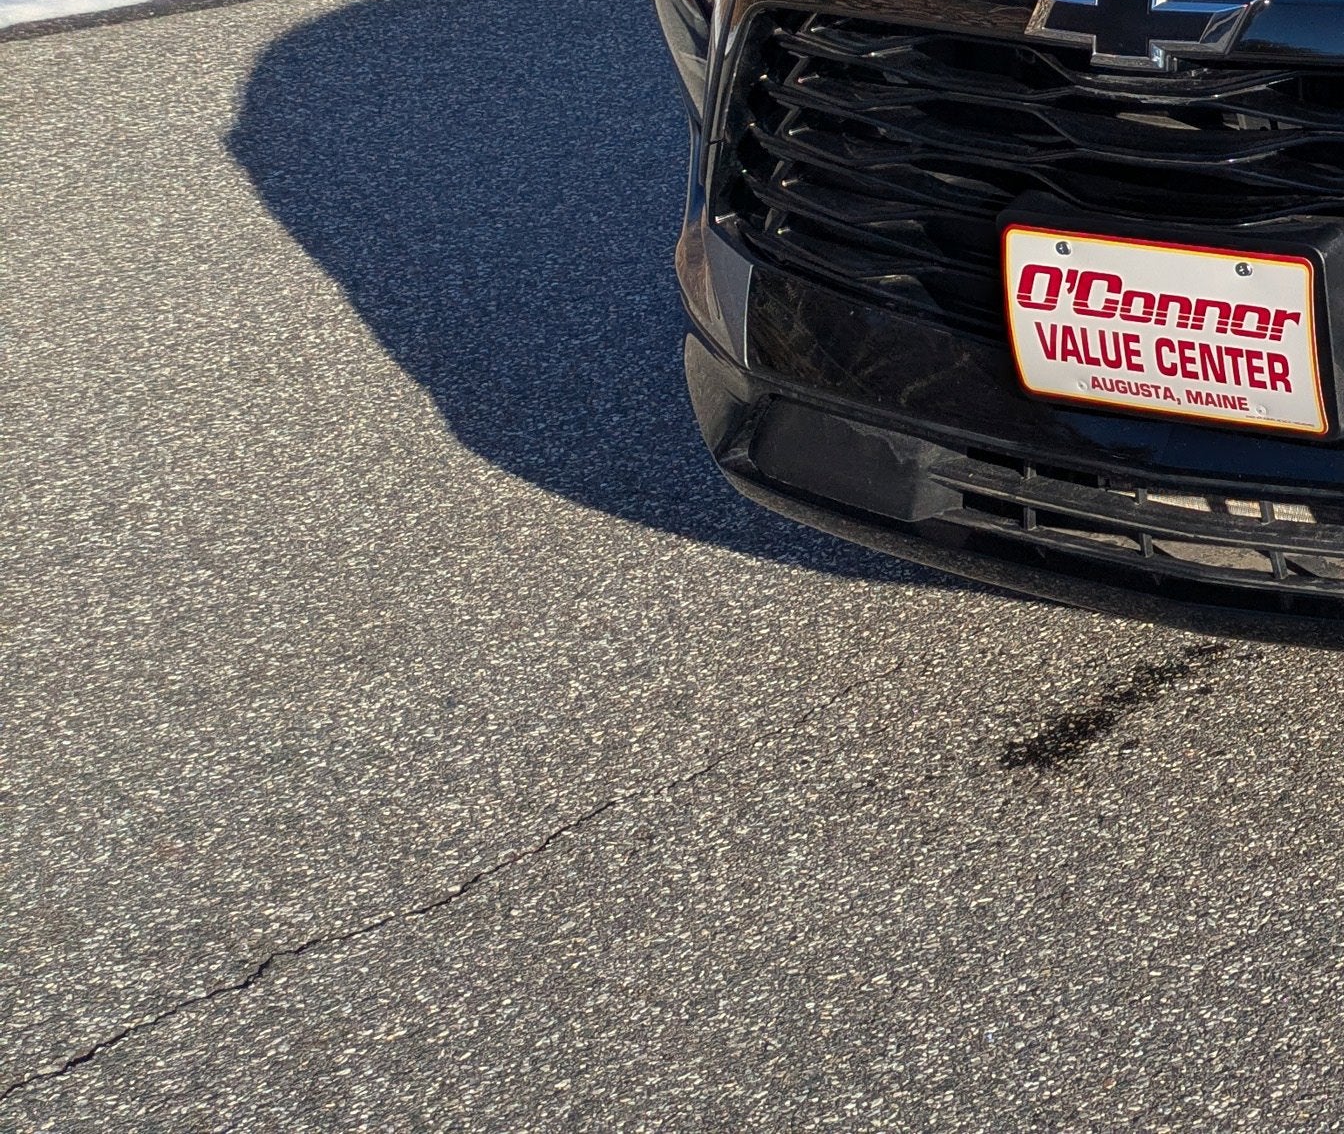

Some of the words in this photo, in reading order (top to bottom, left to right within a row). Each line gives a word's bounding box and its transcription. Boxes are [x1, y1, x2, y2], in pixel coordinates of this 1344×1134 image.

[1015, 263, 1301, 342] O'Connor
[1034, 321, 1145, 373] VALUE
[1154, 338, 1293, 394] CENTER
[1090, 375, 1182, 405] AUGUSTA,
[1186, 389, 1250, 412] MAINE
